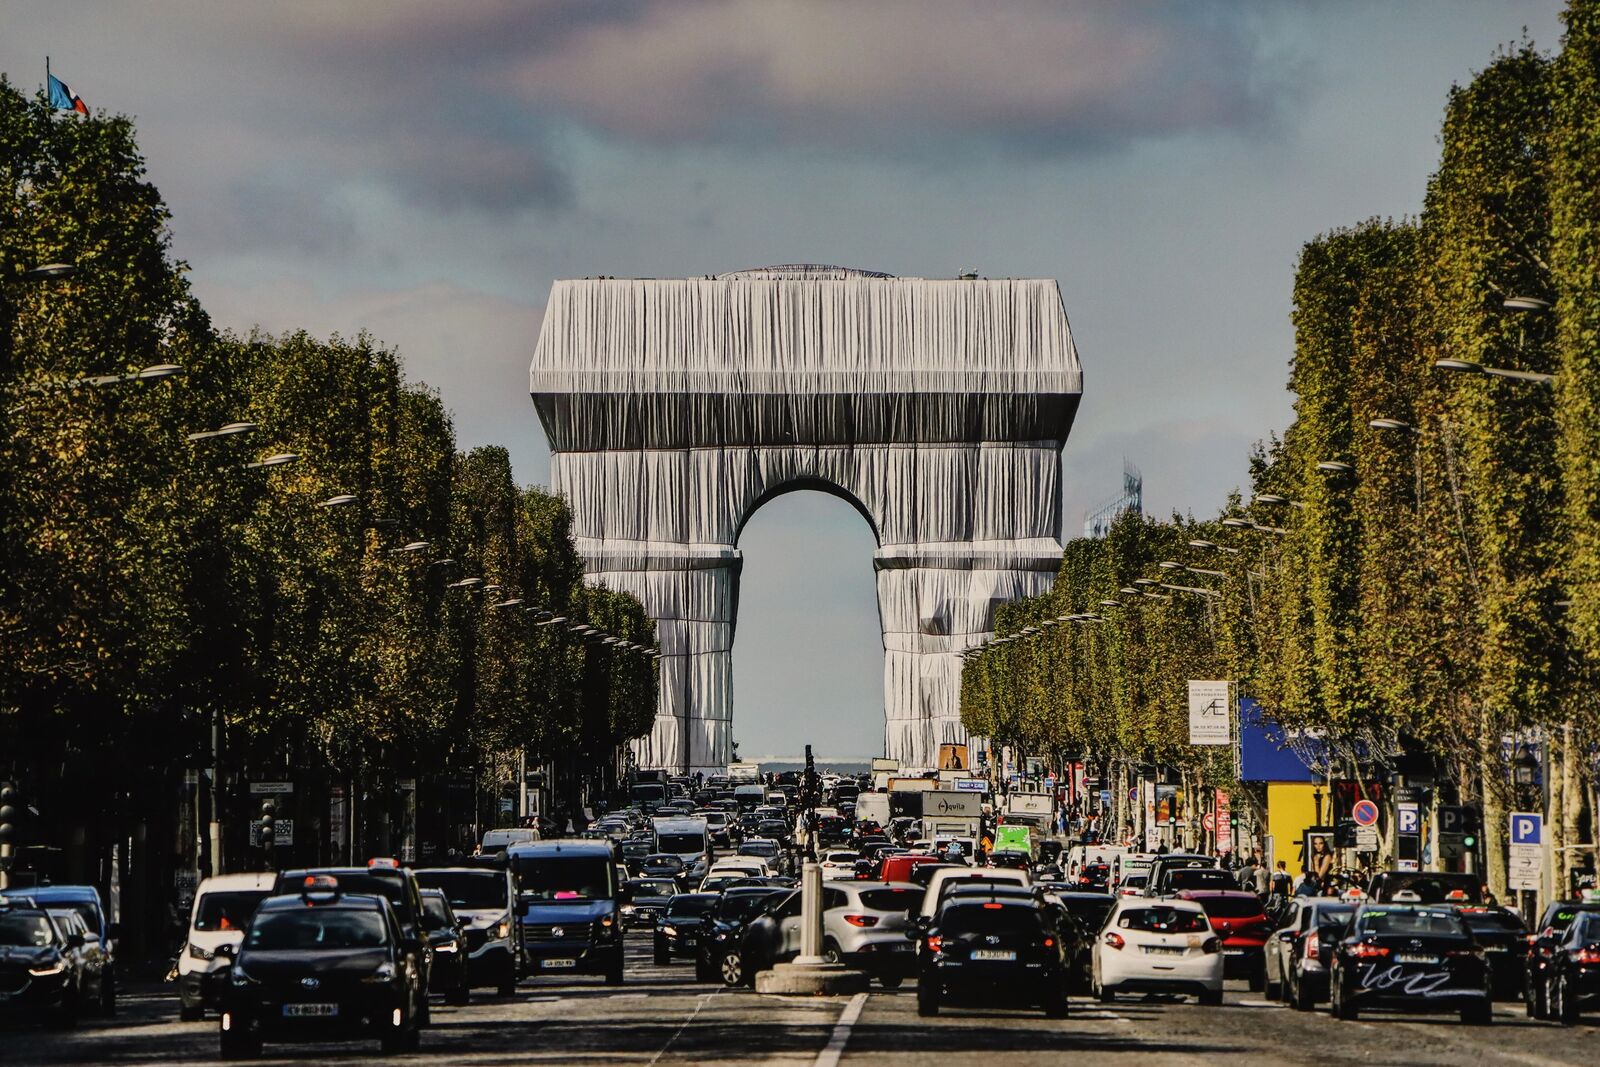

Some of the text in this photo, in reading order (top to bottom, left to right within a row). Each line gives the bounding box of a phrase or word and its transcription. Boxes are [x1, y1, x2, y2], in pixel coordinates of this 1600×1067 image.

[1400, 811, 1416, 831] P
[1444, 811, 1456, 829] P
[1519, 819, 1534, 840] P
